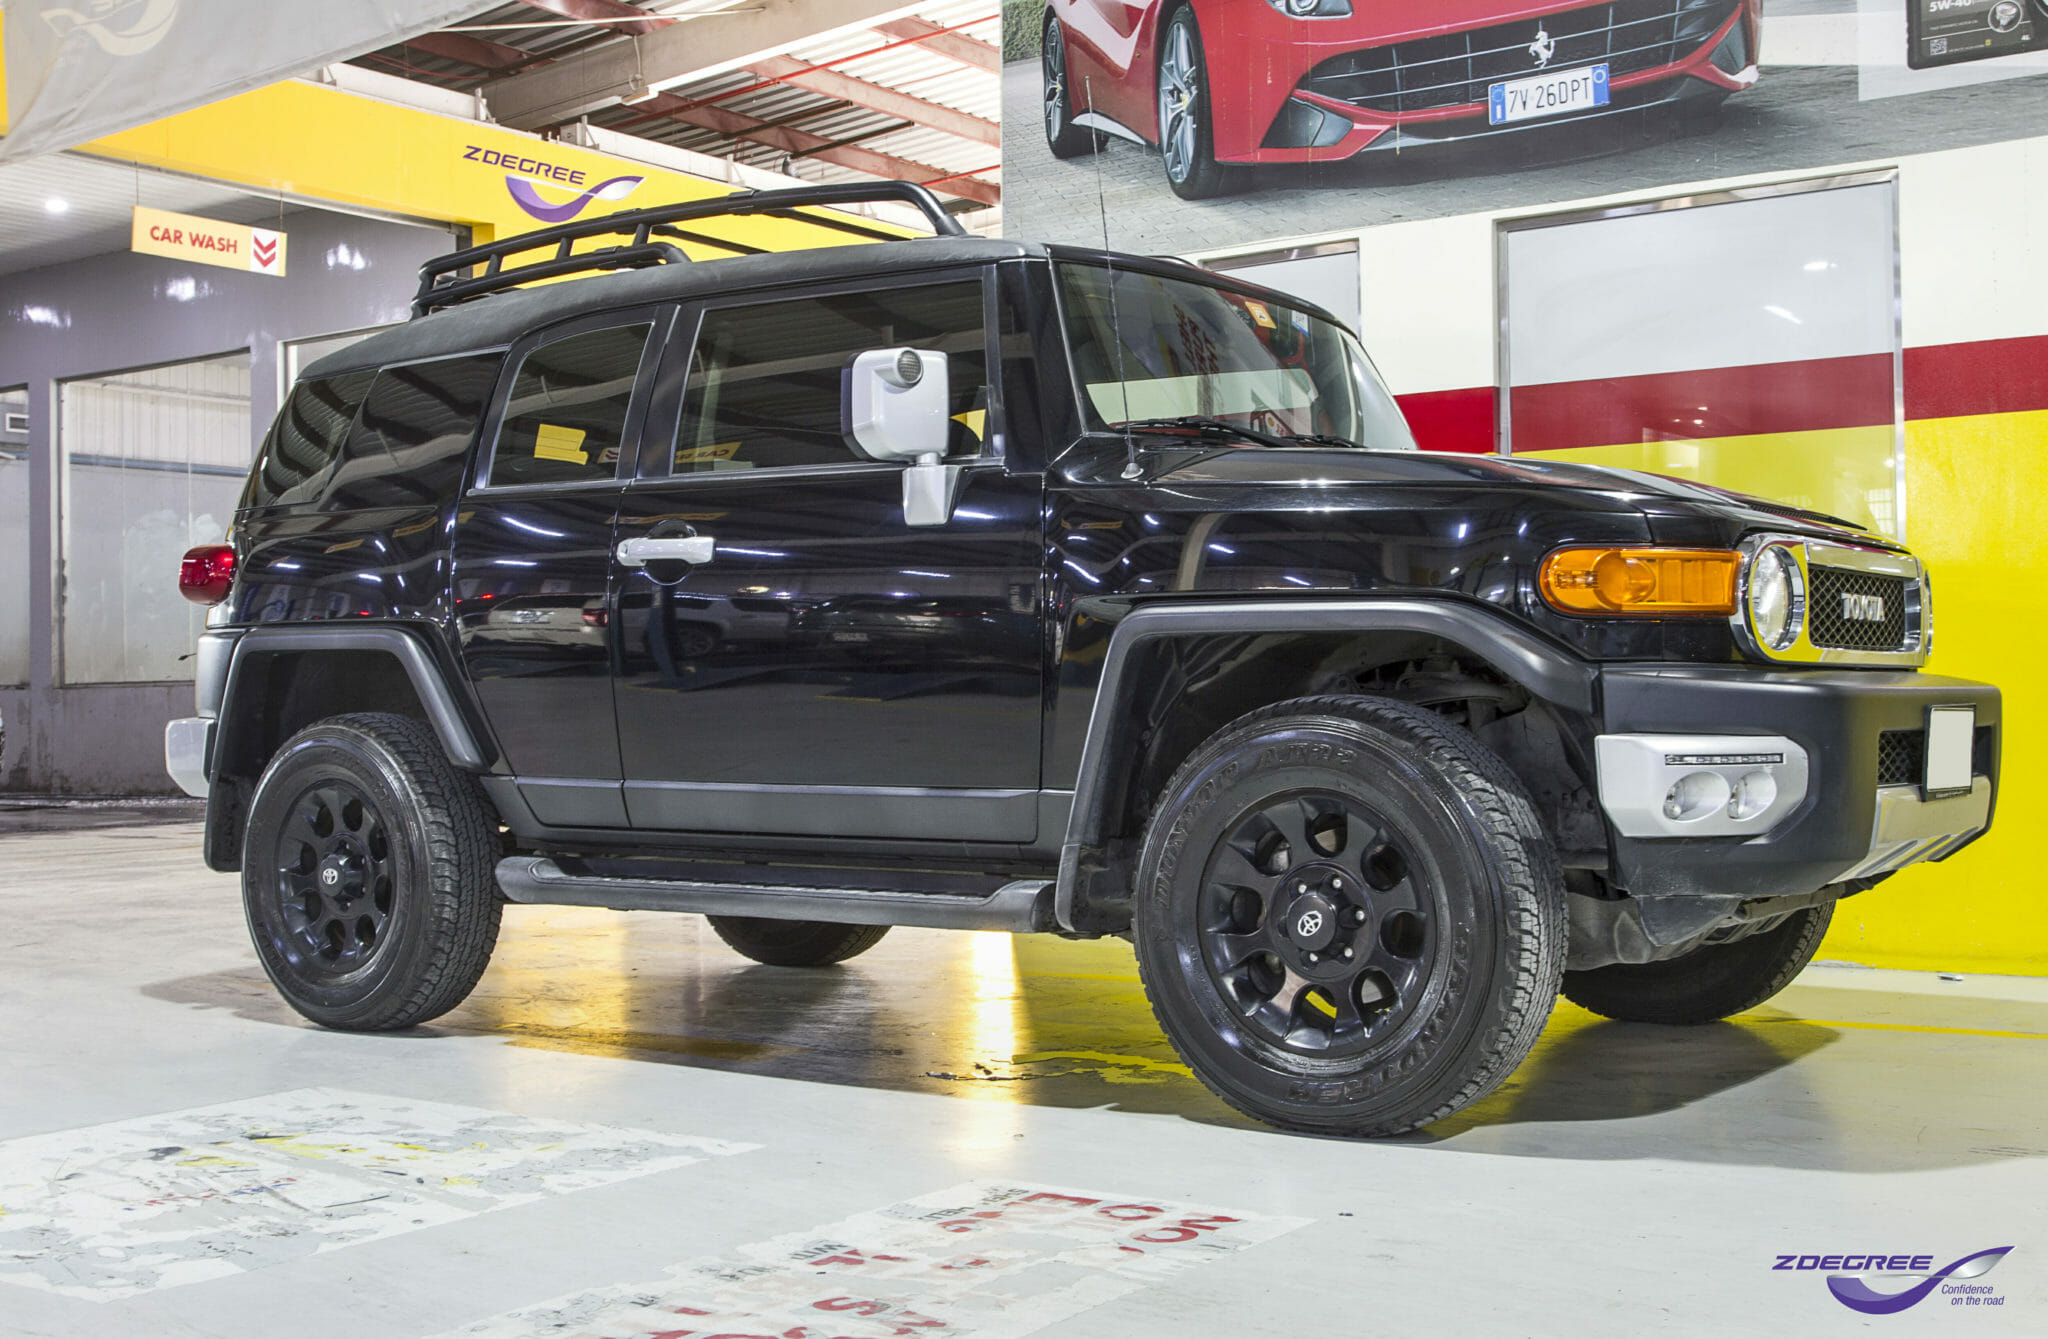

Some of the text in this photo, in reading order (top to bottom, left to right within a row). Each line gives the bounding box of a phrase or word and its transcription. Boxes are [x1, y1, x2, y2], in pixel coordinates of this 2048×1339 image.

[1508, 76, 1591, 113] 7V 26DPT
[462, 144, 587, 185] ZDEGREE
[149, 225, 238, 255] CAR WASH
[1840, 591, 1886, 622] TOYOTA
